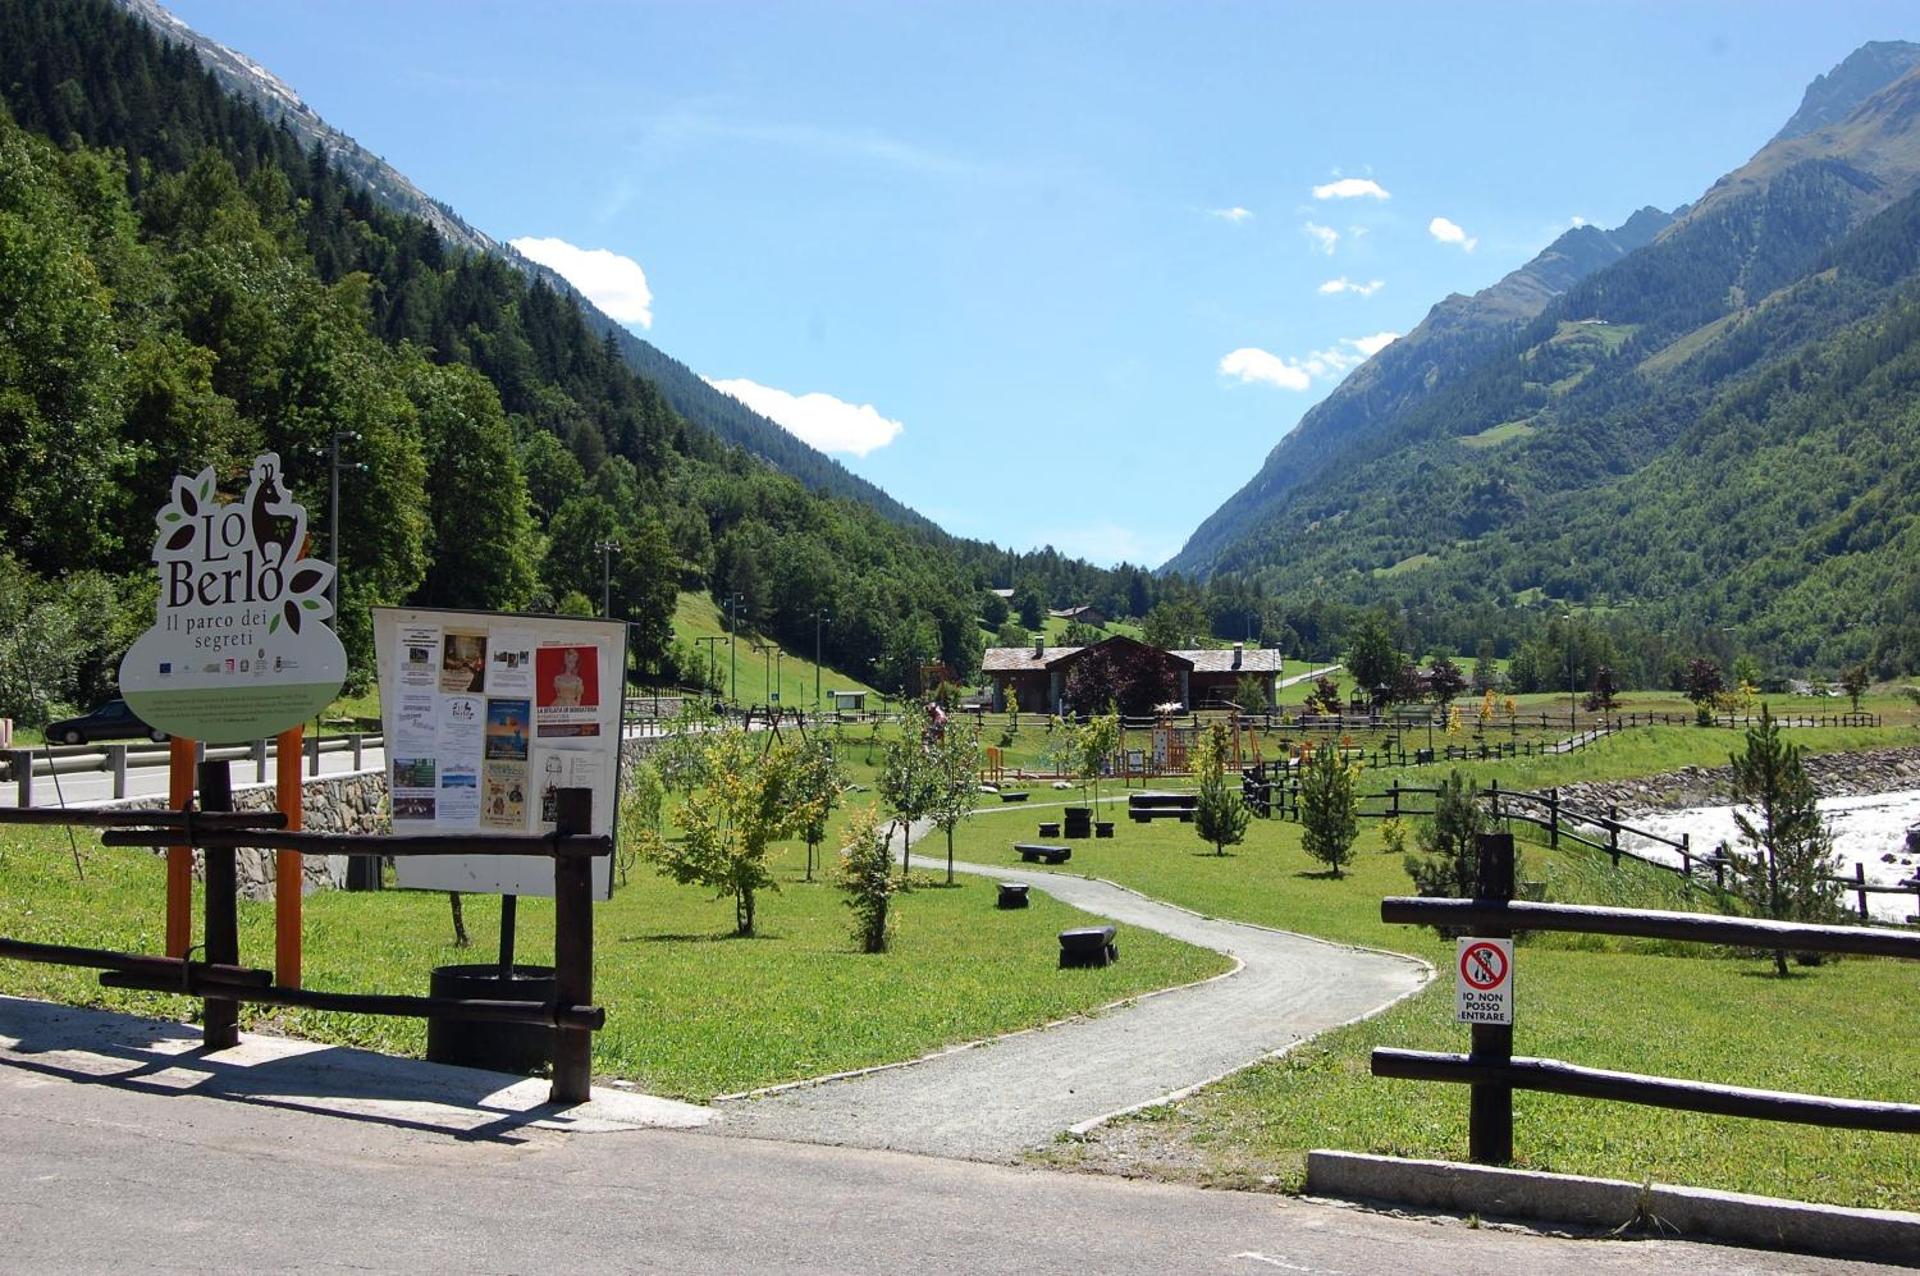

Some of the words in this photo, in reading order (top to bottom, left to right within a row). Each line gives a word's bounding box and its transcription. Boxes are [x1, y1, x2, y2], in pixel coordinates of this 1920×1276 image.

[166, 614, 178, 631] Il
[186, 614, 234, 635] parco
[241, 608, 267, 627] dei
[195, 629, 253, 652] segreti
[1462, 992, 1474, 1001] IO
[1478, 993, 1503, 1002] NON
[1466, 1002, 1500, 1011] POSSO
[1461, 1011, 1505, 1021] ENTRARE
